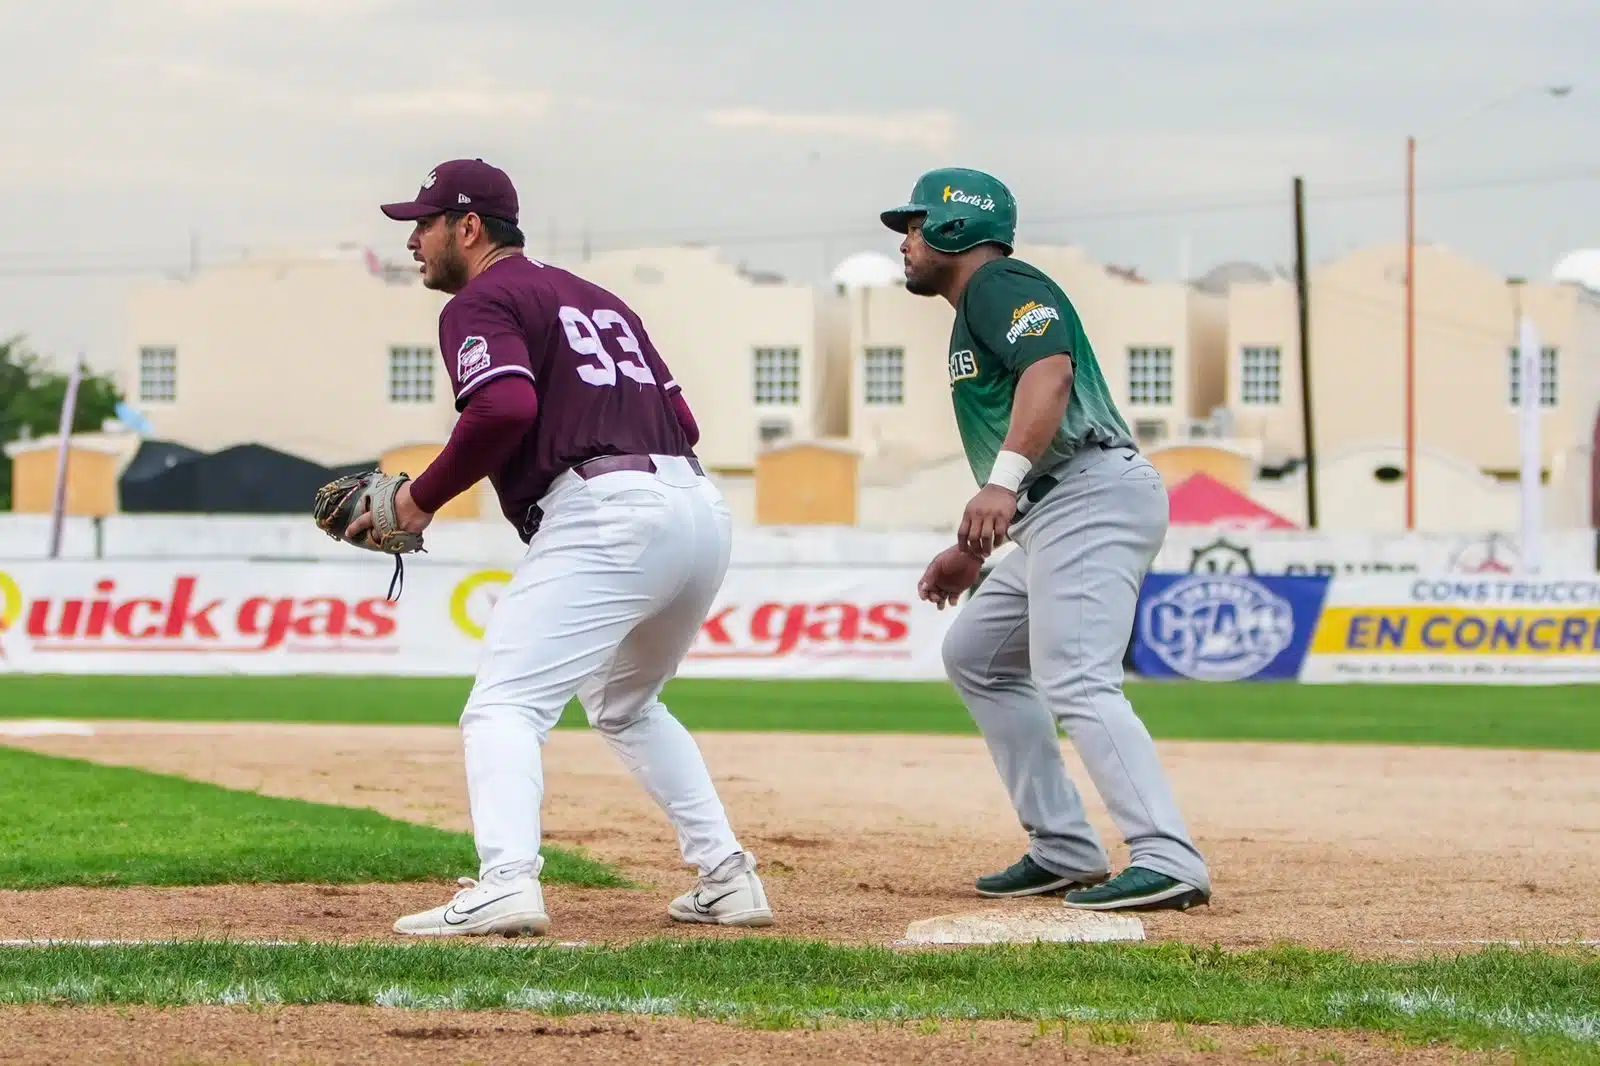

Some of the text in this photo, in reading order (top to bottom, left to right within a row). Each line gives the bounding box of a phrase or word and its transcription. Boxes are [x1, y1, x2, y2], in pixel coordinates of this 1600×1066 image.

[557, 305, 657, 387] 93
[1006, 307, 1060, 345] CAMPEONES
[237, 597, 397, 650] gas
[750, 600, 911, 656] gas
[1346, 615, 1408, 650] EN
